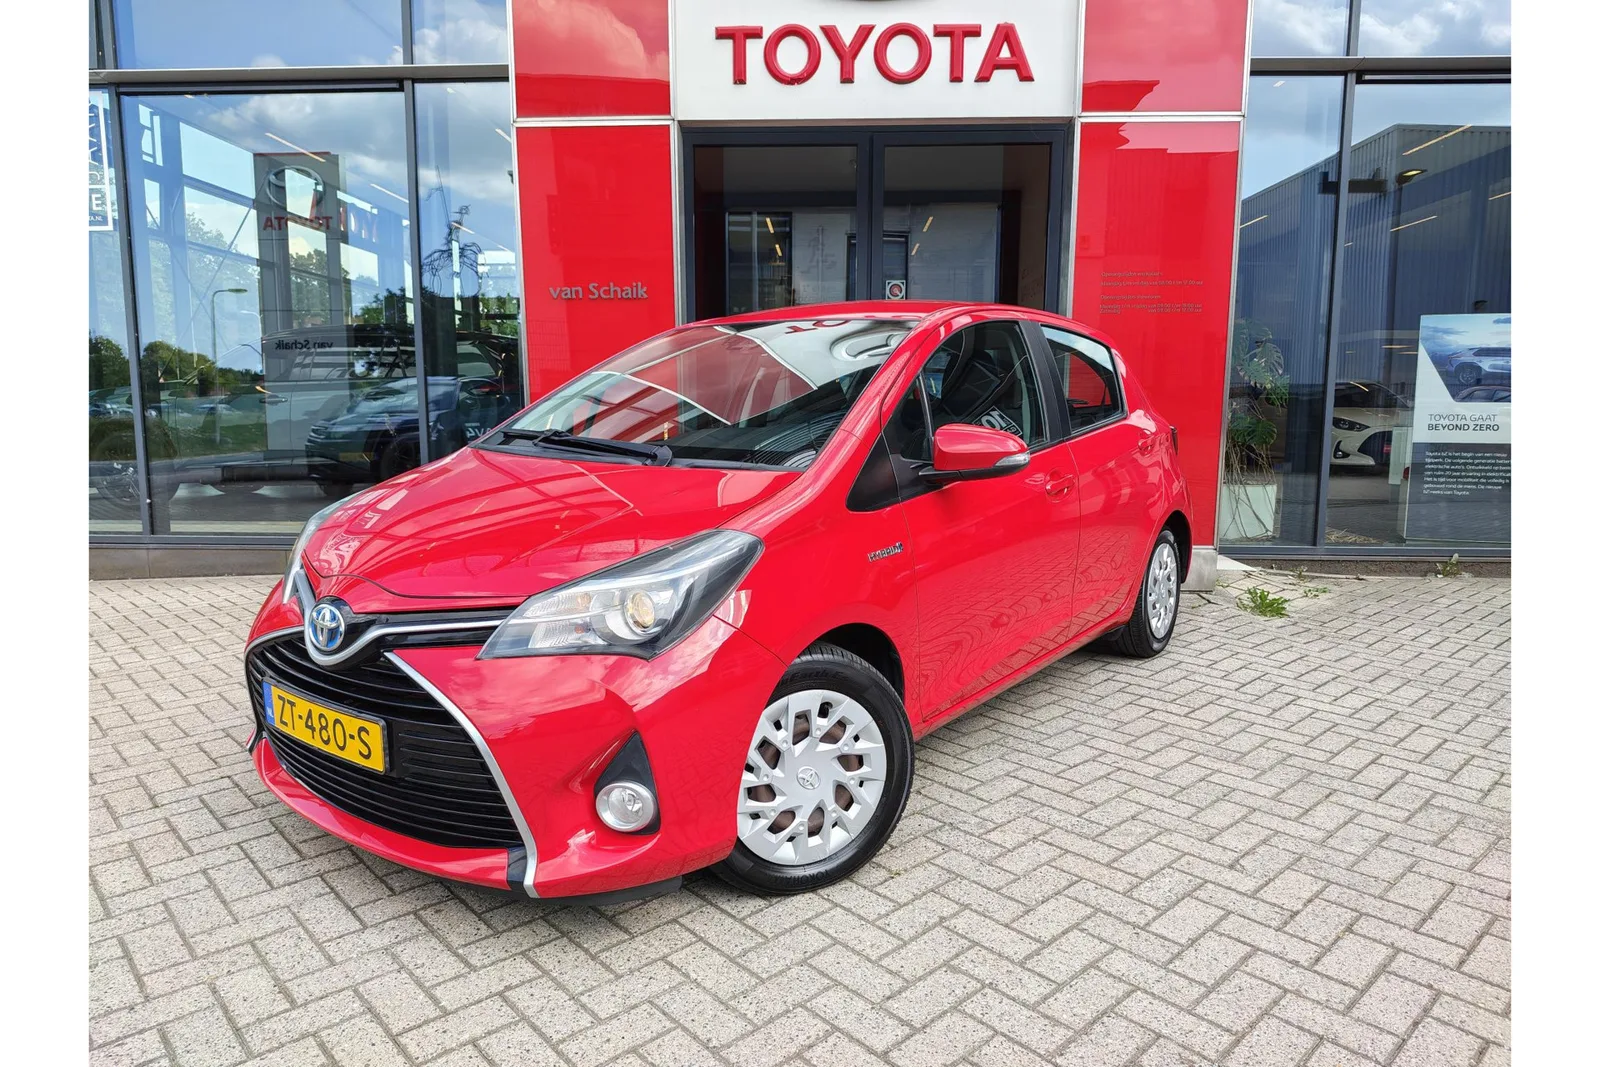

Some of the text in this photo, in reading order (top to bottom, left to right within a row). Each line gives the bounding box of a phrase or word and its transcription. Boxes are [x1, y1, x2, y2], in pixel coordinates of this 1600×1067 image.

[715, 22, 1035, 85] TOYOTA
[549, 281, 648, 299] van Schaik
[1428, 414, 1497, 422] TOYOTA GAAT
[277, 694, 372, 760] ZT-480-S
